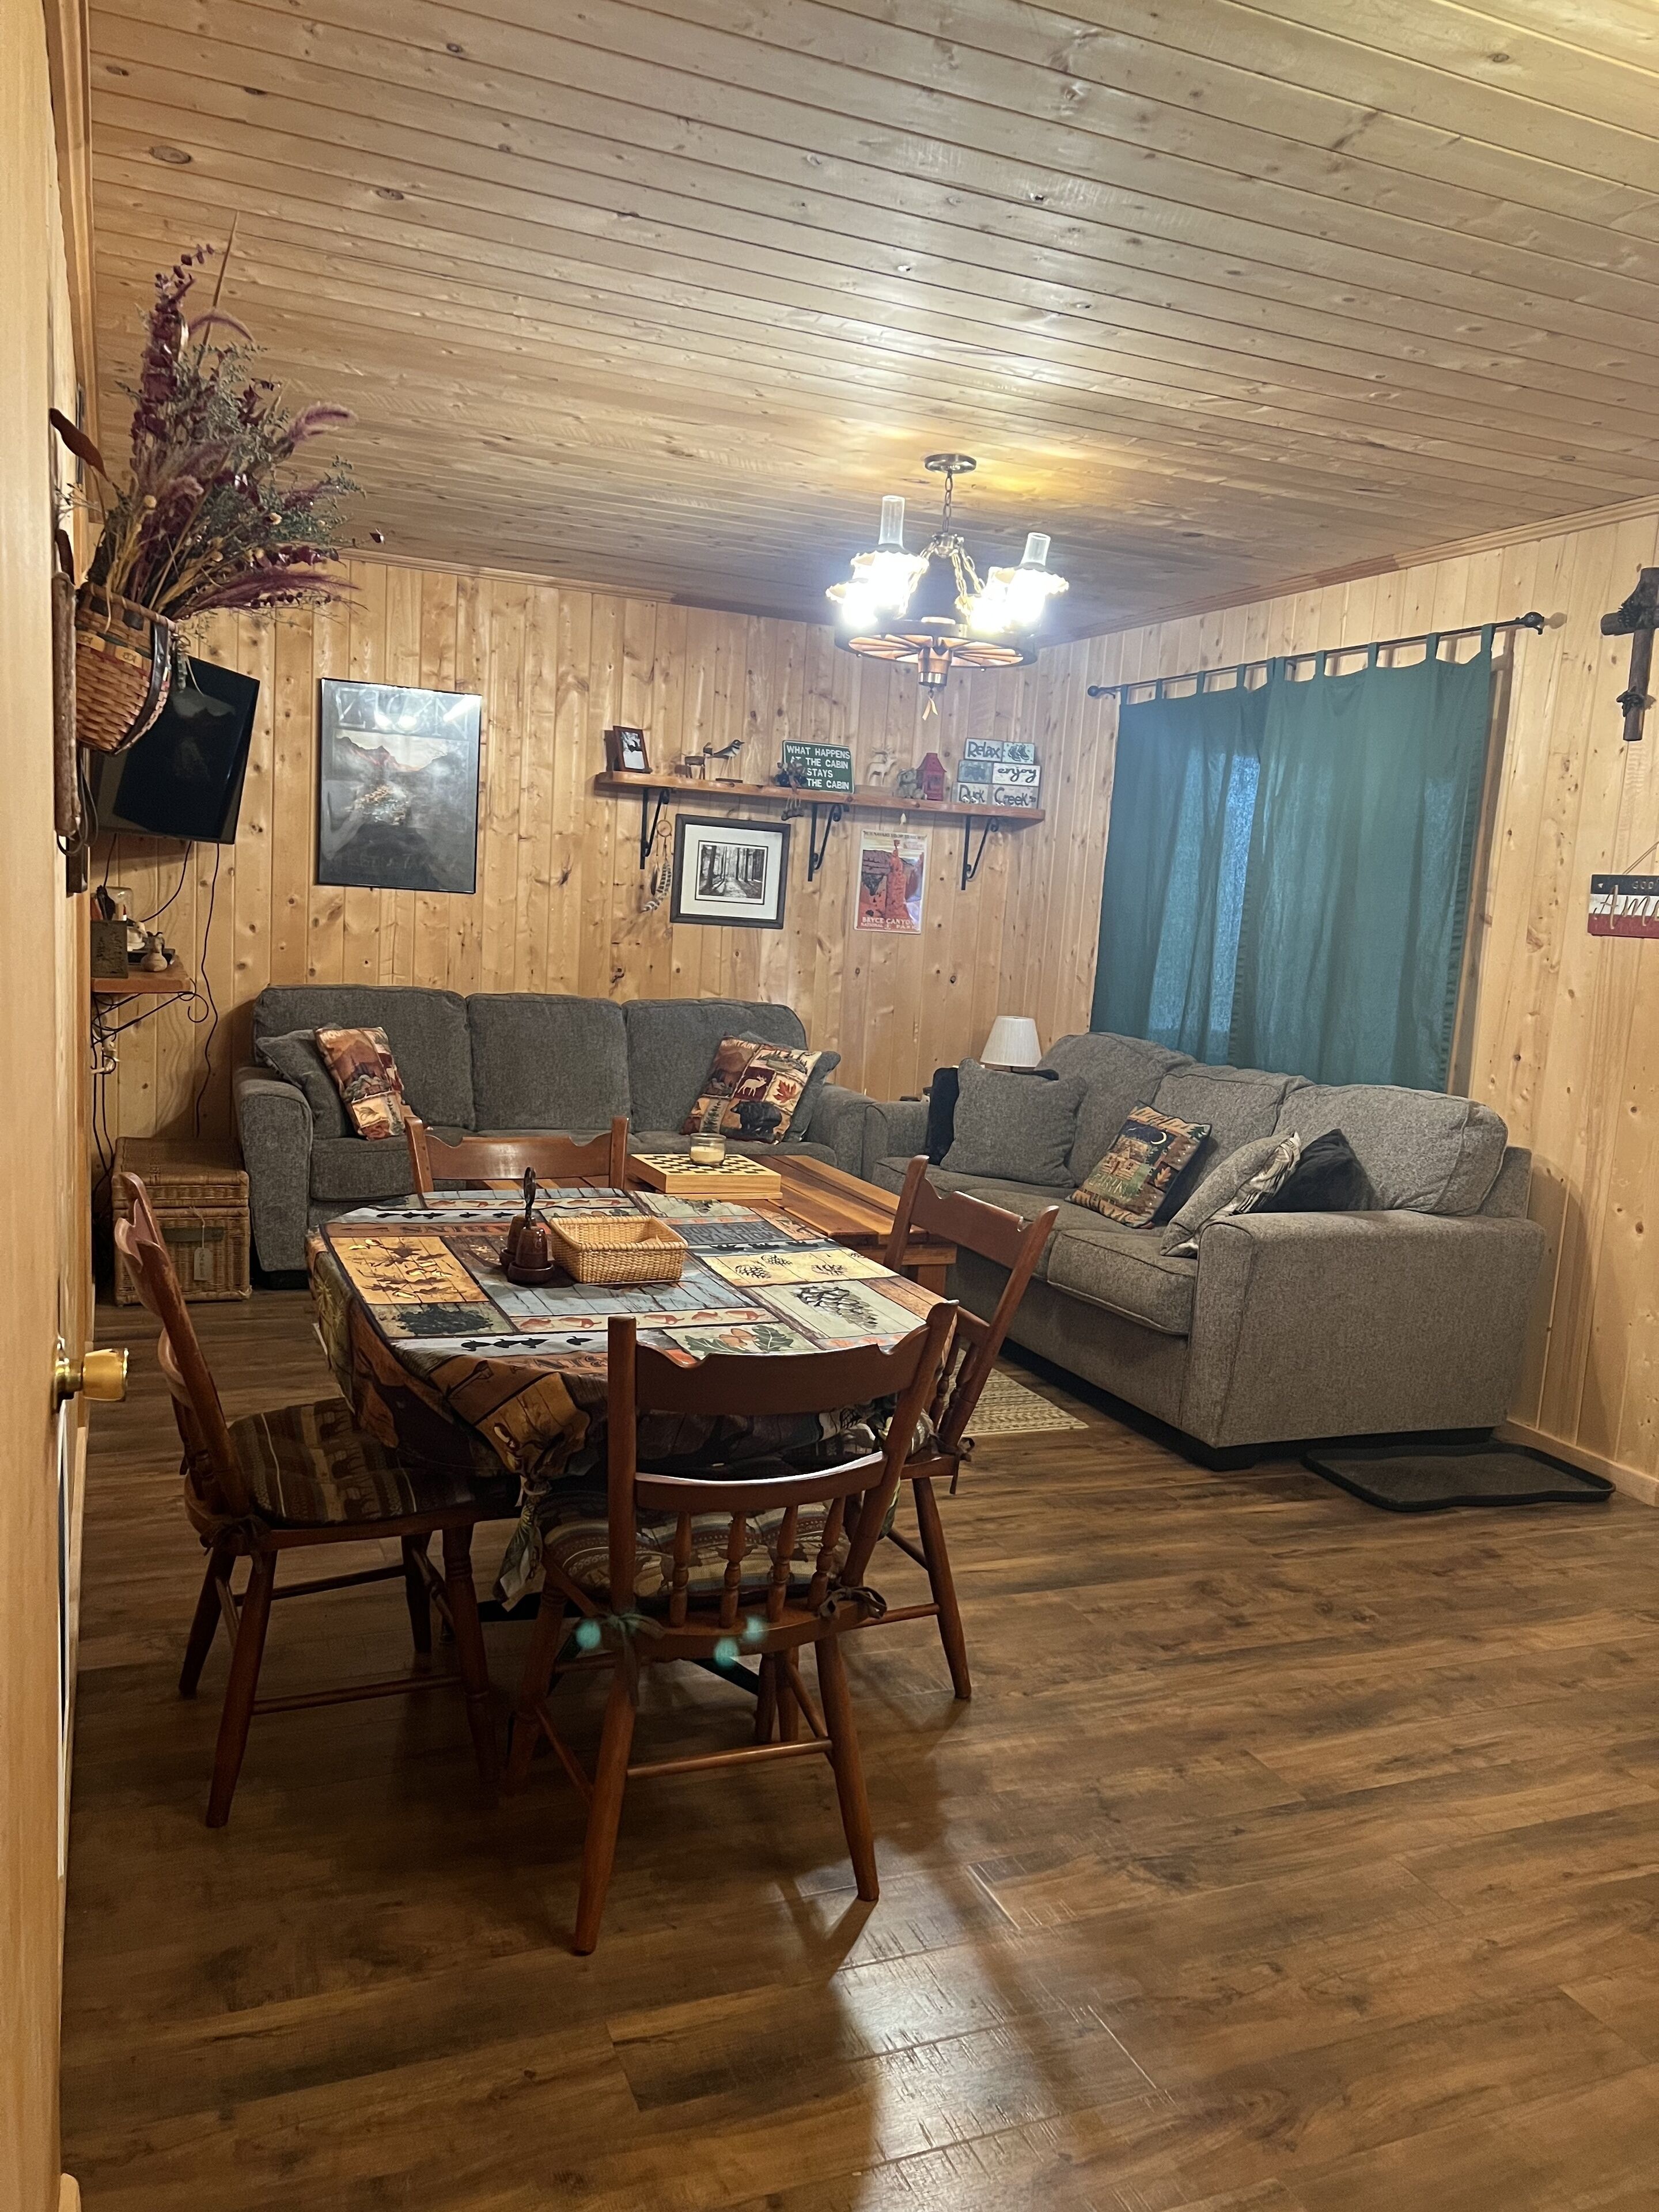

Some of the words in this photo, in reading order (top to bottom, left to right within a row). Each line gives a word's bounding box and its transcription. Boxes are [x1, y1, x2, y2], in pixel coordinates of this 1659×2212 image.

[786, 745, 811, 756] WHAT
[815, 748, 850, 760] HAPPENS
[967, 741, 1001, 759] Relax
[805, 757, 821, 767] THE
[825, 759, 849, 770] CABIN
[806, 768, 834, 778] STAYS
[997, 766, 1037, 783] enjoy
[806, 778, 823, 787] THE
[826, 780, 850, 790] CABIN
